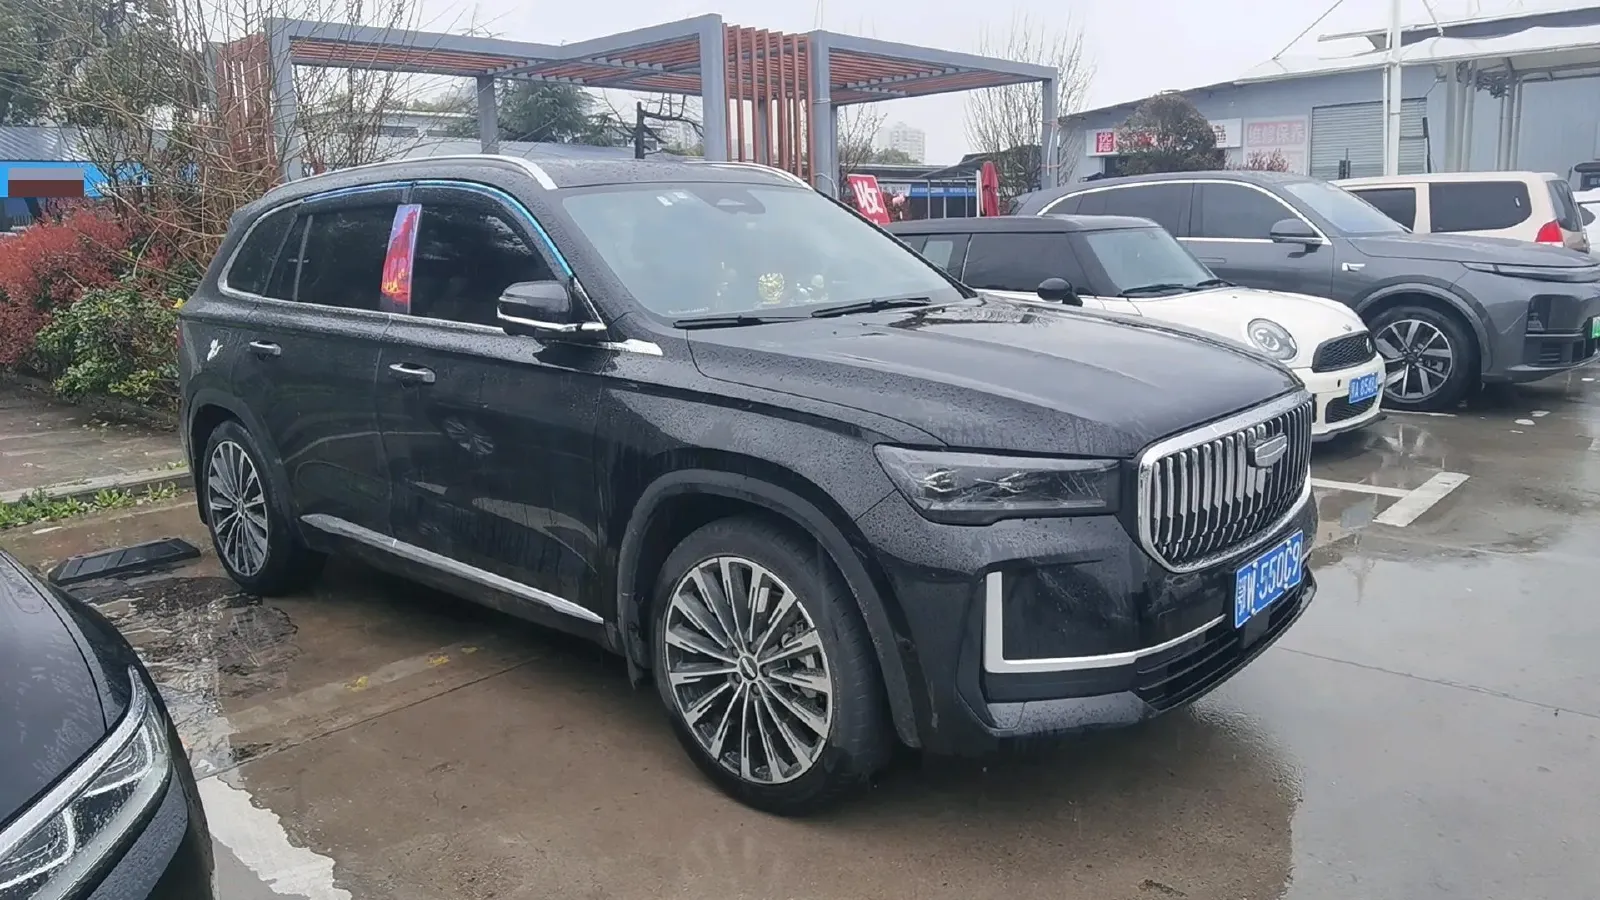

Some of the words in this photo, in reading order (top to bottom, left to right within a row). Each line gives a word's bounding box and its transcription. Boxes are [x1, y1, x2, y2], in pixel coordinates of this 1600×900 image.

[1249, 124, 1305, 145] 维修保养
[853, 180, 884, 224] 收
